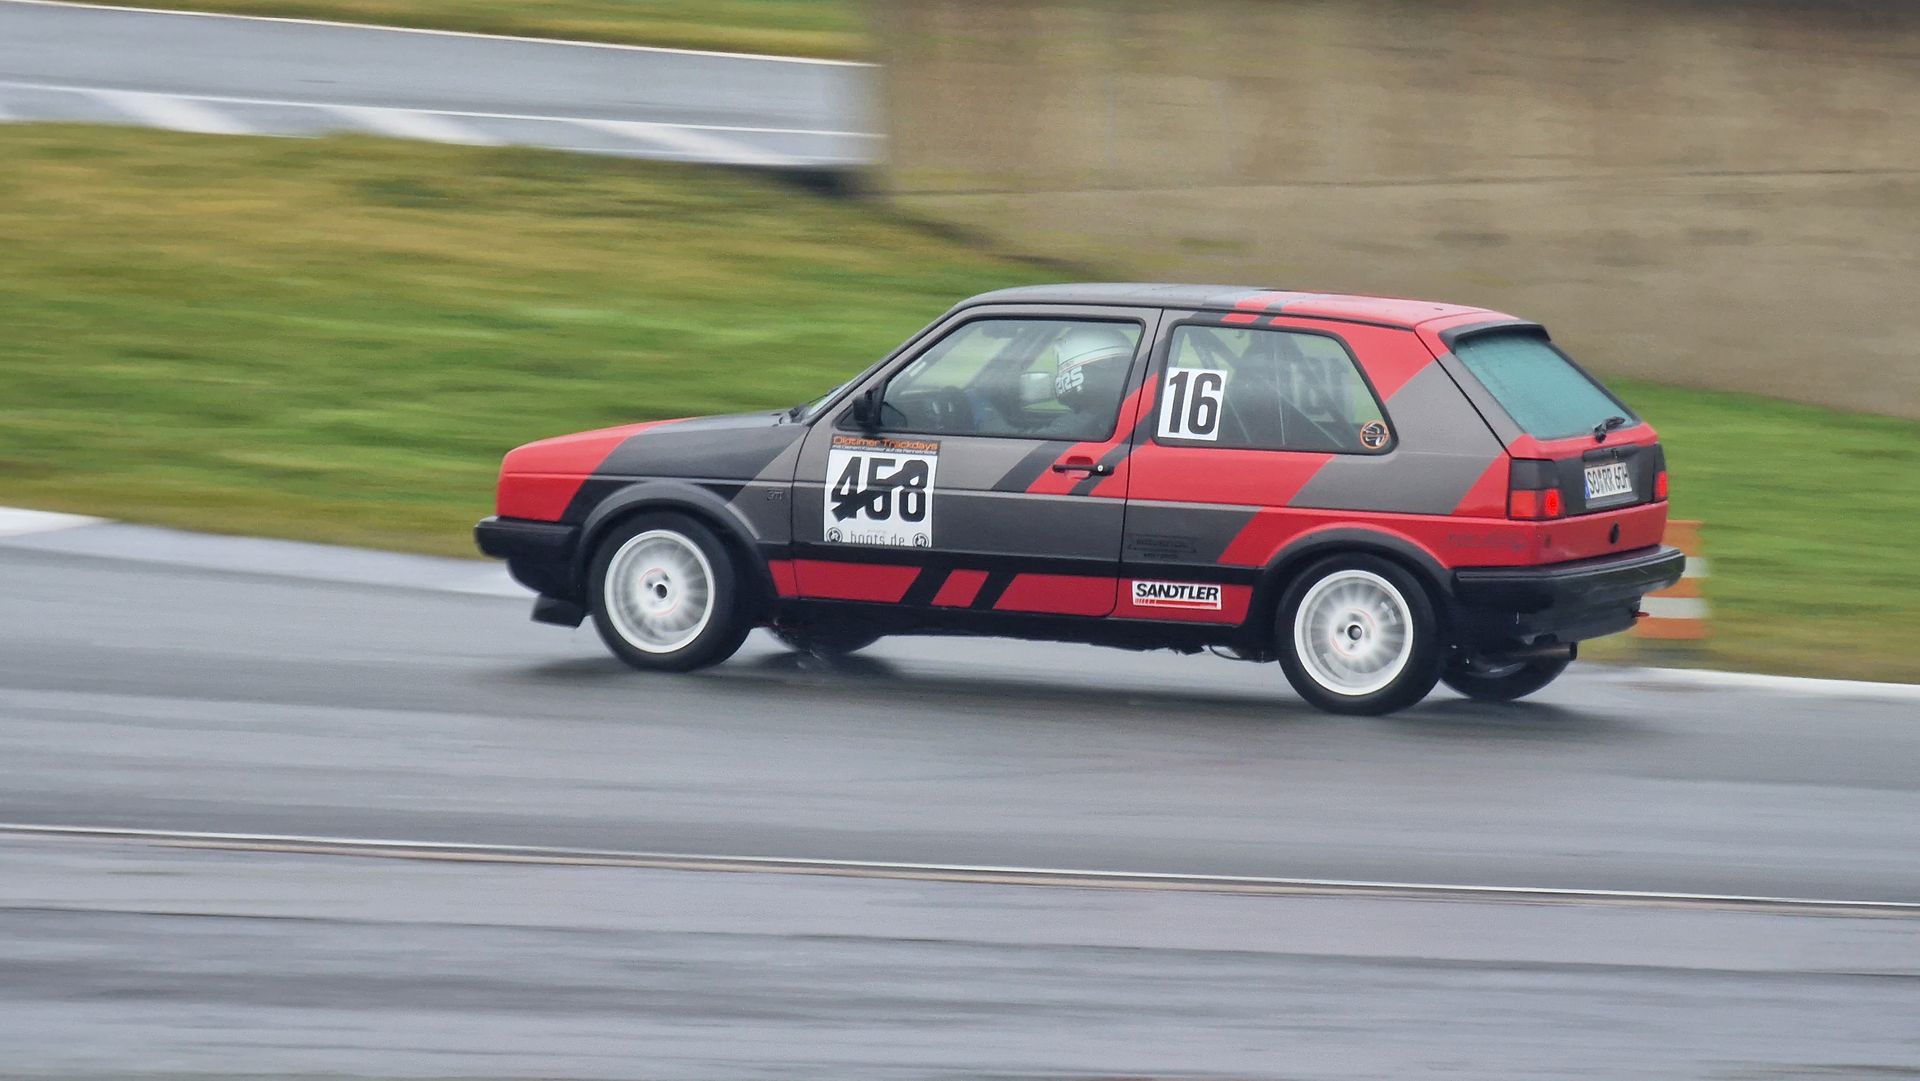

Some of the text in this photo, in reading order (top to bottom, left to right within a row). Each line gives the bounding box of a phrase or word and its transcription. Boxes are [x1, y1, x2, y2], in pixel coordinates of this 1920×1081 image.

[1168, 371, 1222, 435] 16
[833, 435, 938, 451] Oldtimer Trackdays
[1136, 583, 1219, 600] SANDTLER
